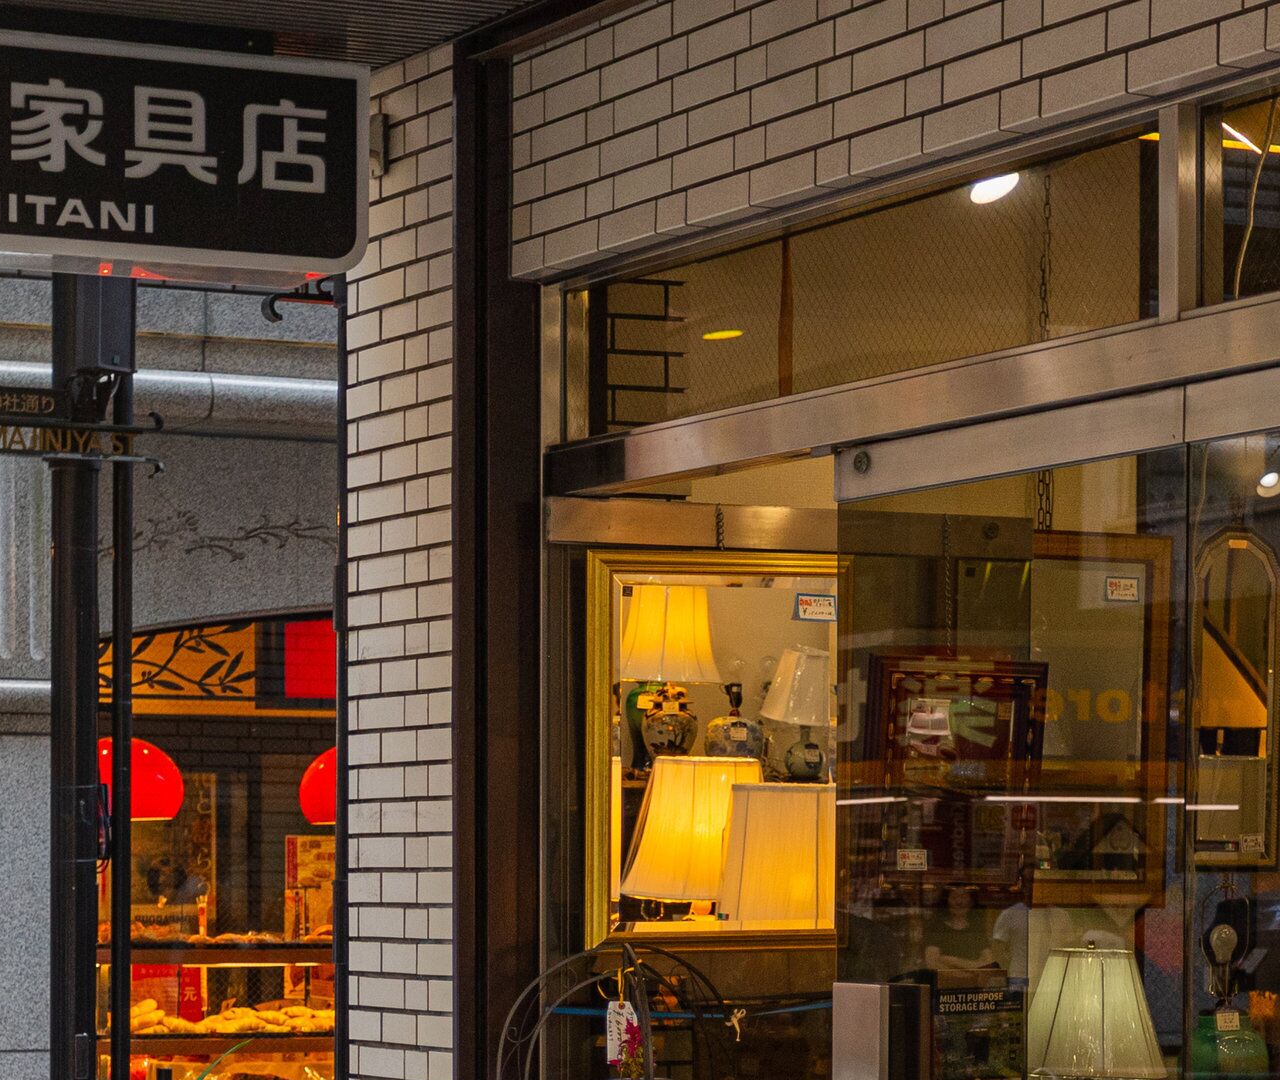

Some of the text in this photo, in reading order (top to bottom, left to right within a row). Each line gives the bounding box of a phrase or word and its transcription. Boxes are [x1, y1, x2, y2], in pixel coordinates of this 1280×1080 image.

[112, 431, 138, 455] ST
[940, 992, 1005, 1004] MULTI PURPOSE
[940, 1001, 997, 1013] STORAGE BAG
